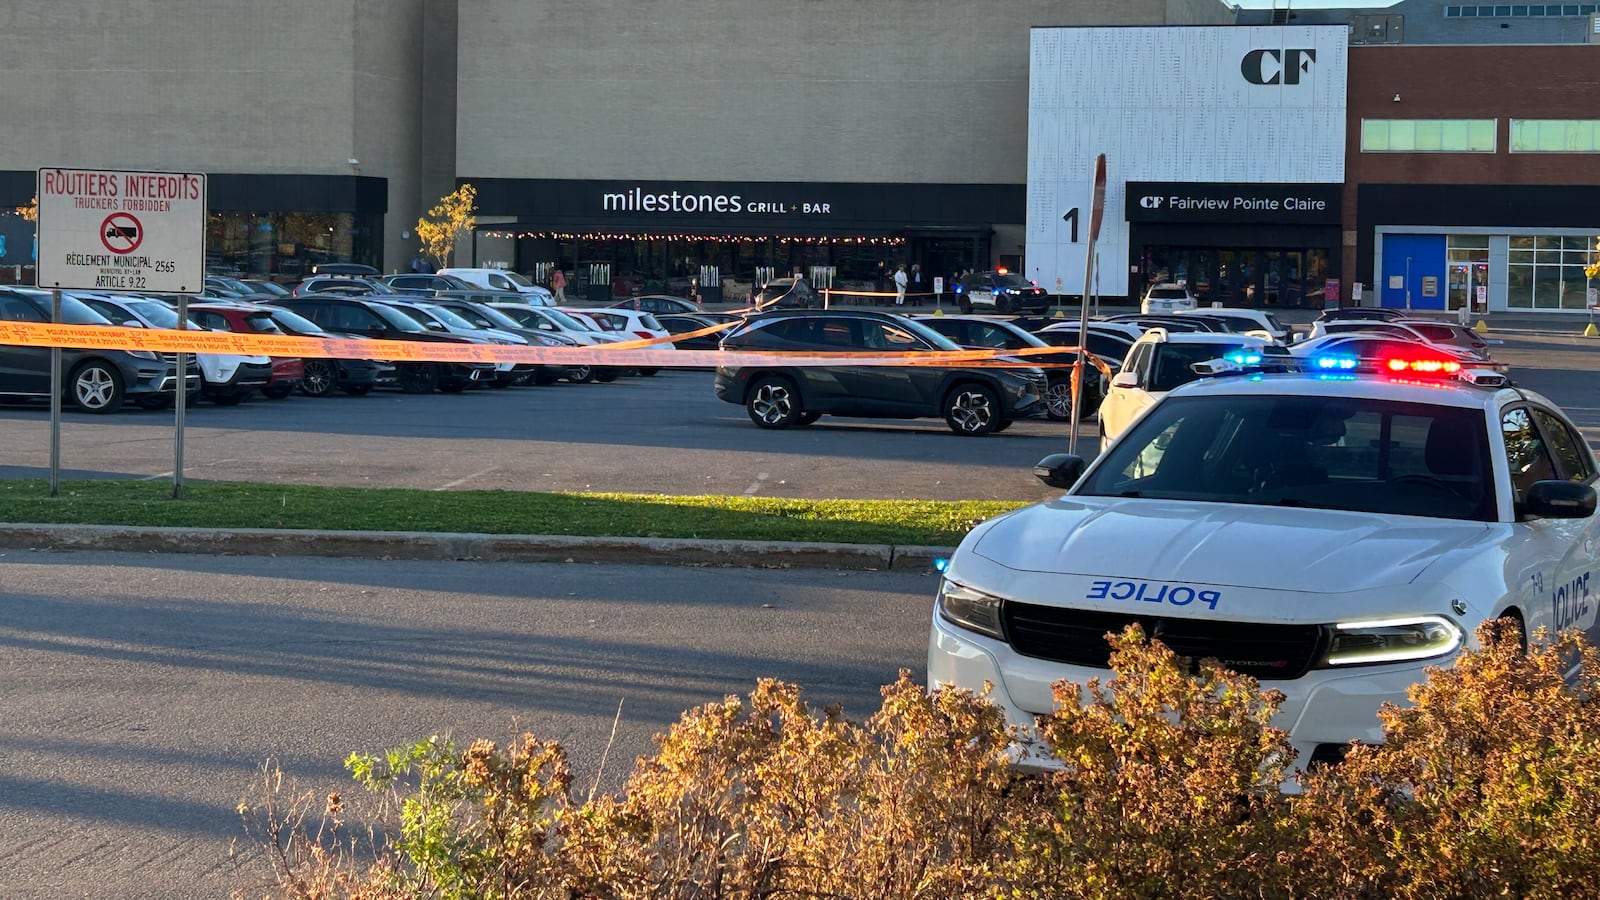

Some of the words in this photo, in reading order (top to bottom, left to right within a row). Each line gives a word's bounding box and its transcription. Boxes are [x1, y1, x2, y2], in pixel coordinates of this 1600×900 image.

[1240, 49, 1316, 85] CF
[45, 172, 118, 197] ROUTIERS
[125, 175, 199, 200] INTERDITS
[74, 197, 118, 210] TRUCKERS
[122, 199, 171, 212] FORBIDDEN
[603, 187, 742, 213] milestones
[747, 202, 787, 214] GRILL
[802, 203, 831, 214] BAR
[1140, 196, 1164, 209] CF
[1169, 196, 1229, 210] Fairview
[1233, 197, 1280, 210] Pointe
[1283, 197, 1326, 211] Claire
[1062, 207, 1079, 243] 1
[113, 255, 153, 269] MUNICIPAL
[155, 260, 175, 273] 2565
[95, 276, 126, 288] ARTICLE
[128, 276, 146, 289] 9.22
